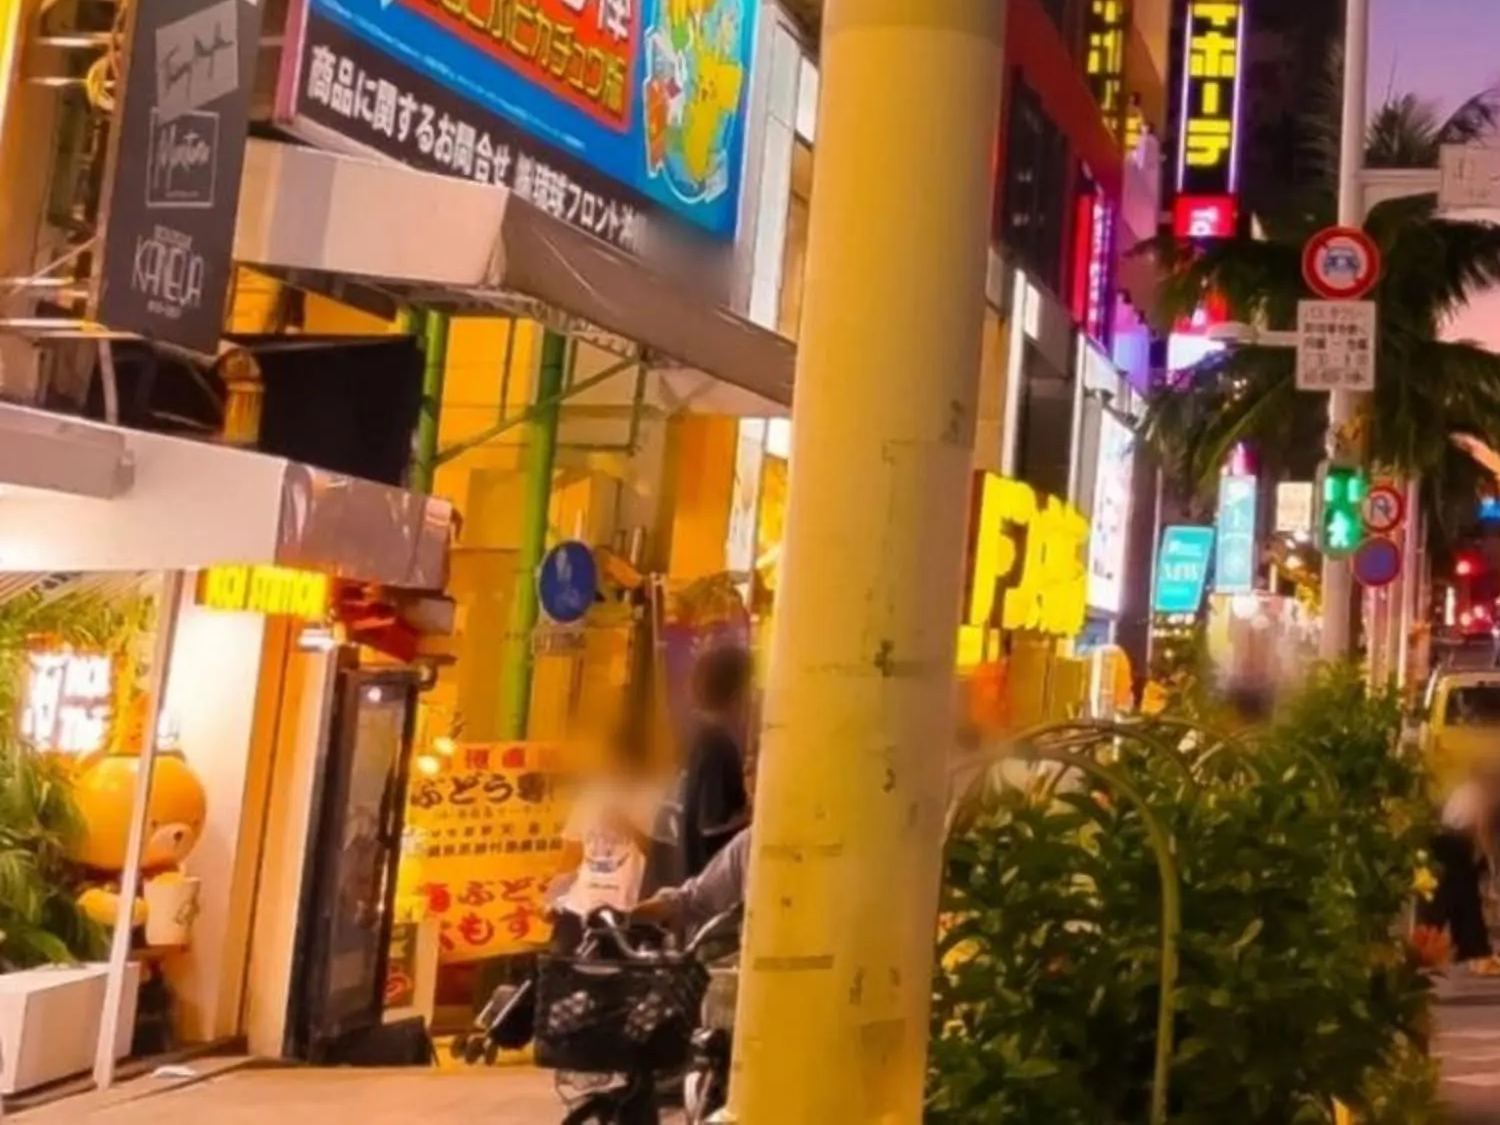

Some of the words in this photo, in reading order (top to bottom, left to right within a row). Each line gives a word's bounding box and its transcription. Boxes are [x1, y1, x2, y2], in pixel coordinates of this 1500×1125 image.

[310, 43, 511, 189] 商品に関するお問合せ
